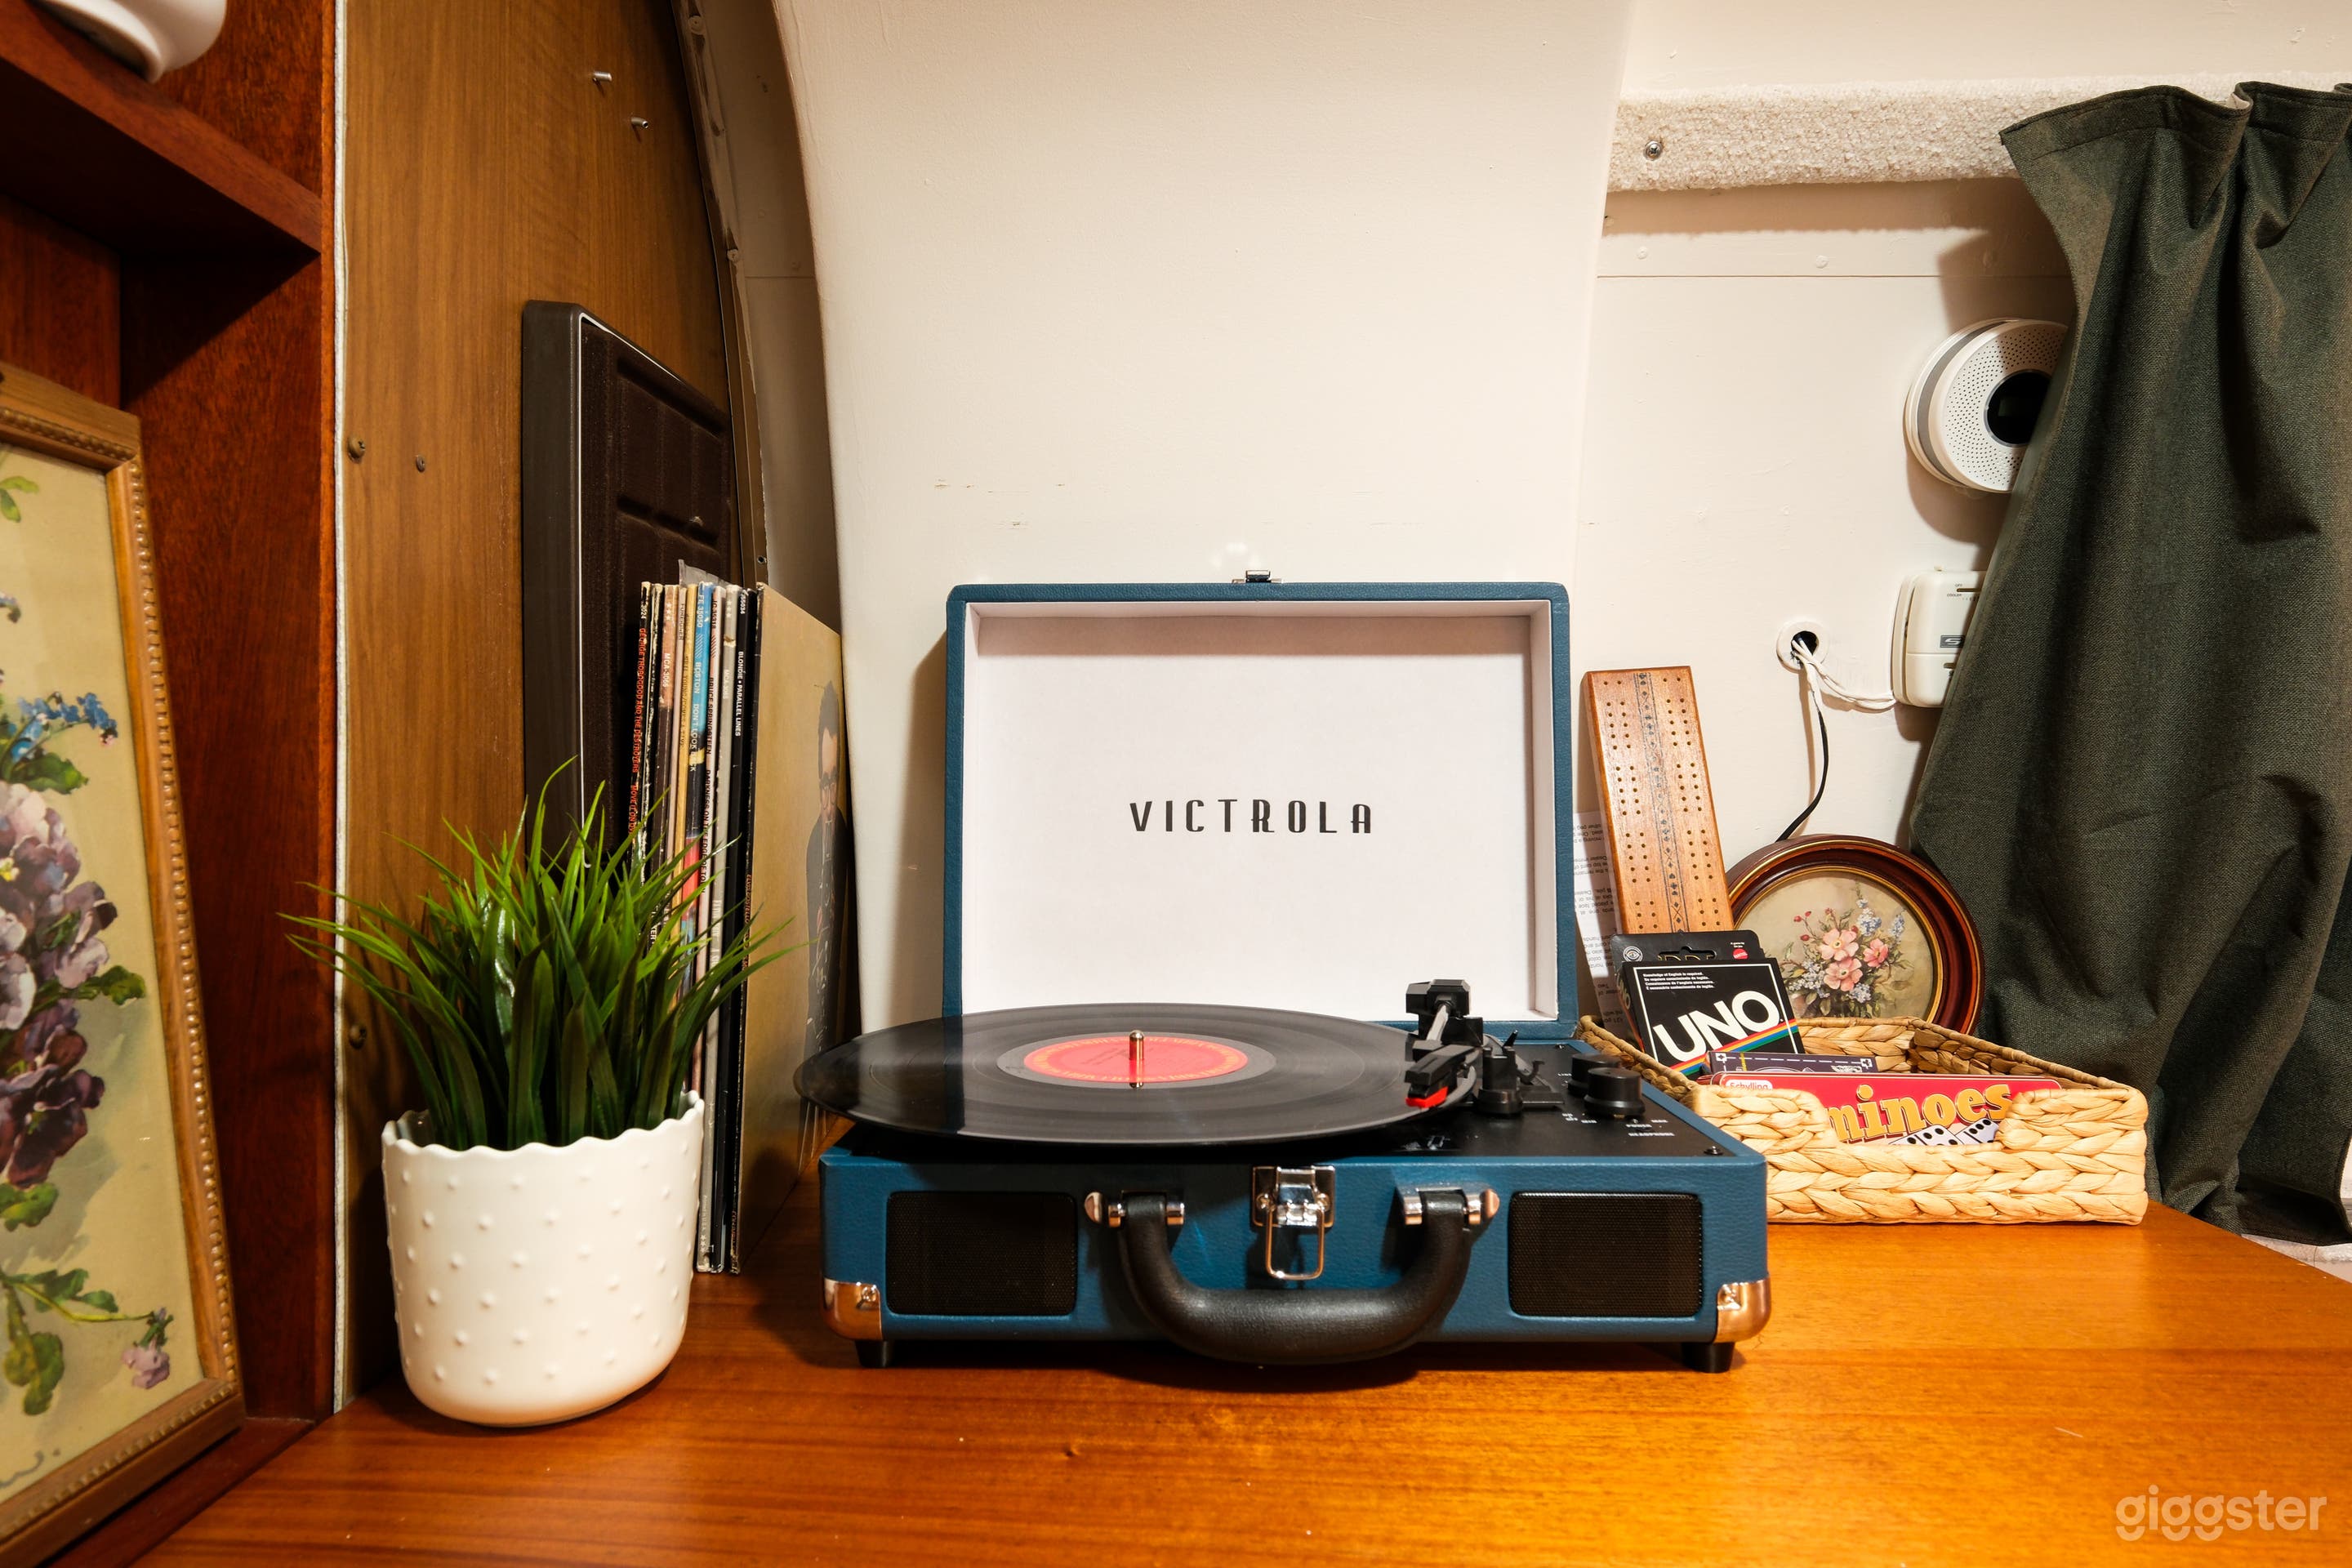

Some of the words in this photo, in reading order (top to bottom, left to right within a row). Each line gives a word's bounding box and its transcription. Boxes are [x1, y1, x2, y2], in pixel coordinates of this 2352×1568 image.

[697, 594, 705, 604] FE
[694, 662, 702, 694] BOSTON
[690, 728, 698, 750] LOOK
[706, 704, 714, 755] SPRINGSTEEN
[632, 729, 641, 773] DESTROYERS
[703, 769, 712, 809] DARKNESS
[703, 811, 710, 821] ON
[1129, 799, 1371, 833] VICTROLA
[1652, 991, 1780, 1062] UNO
